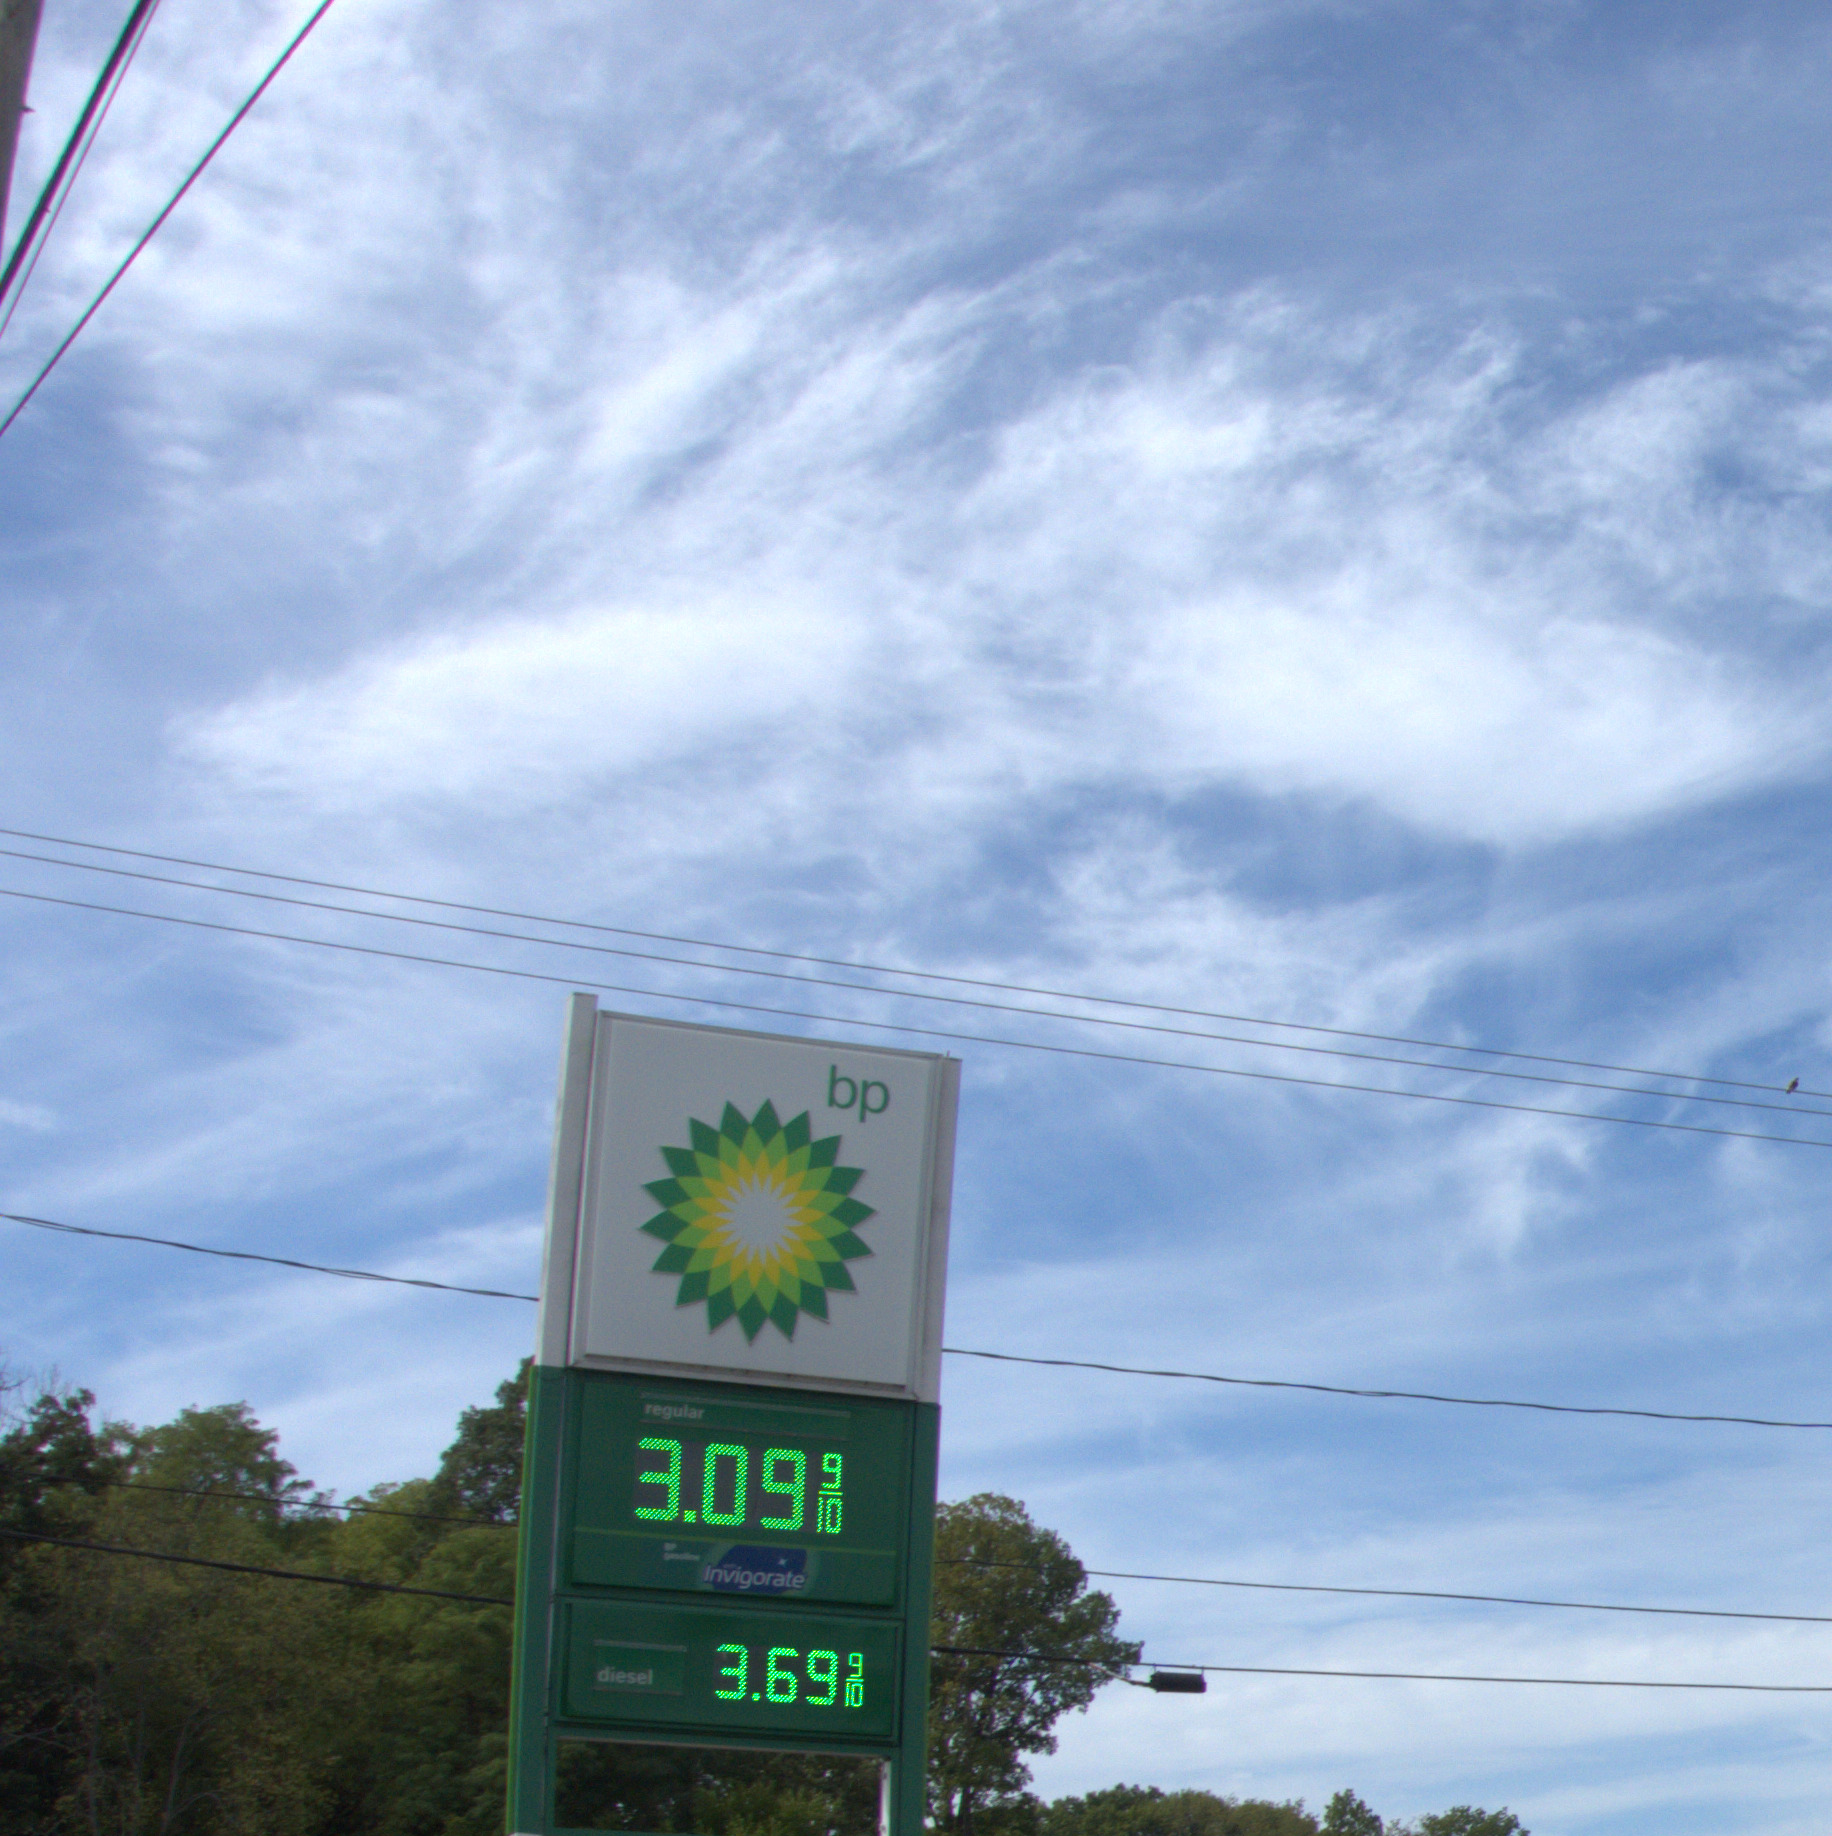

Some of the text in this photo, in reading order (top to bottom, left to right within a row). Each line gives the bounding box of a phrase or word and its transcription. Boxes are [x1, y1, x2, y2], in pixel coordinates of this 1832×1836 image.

[827, 1064, 890, 1123] bp
[643, 1403, 705, 1420] regular
[634, 1437, 807, 1531] 3.09
[703, 1564, 807, 1590] Invigorate
[597, 1667, 654, 1686] diesel
[714, 1643, 838, 1706] 3.69
